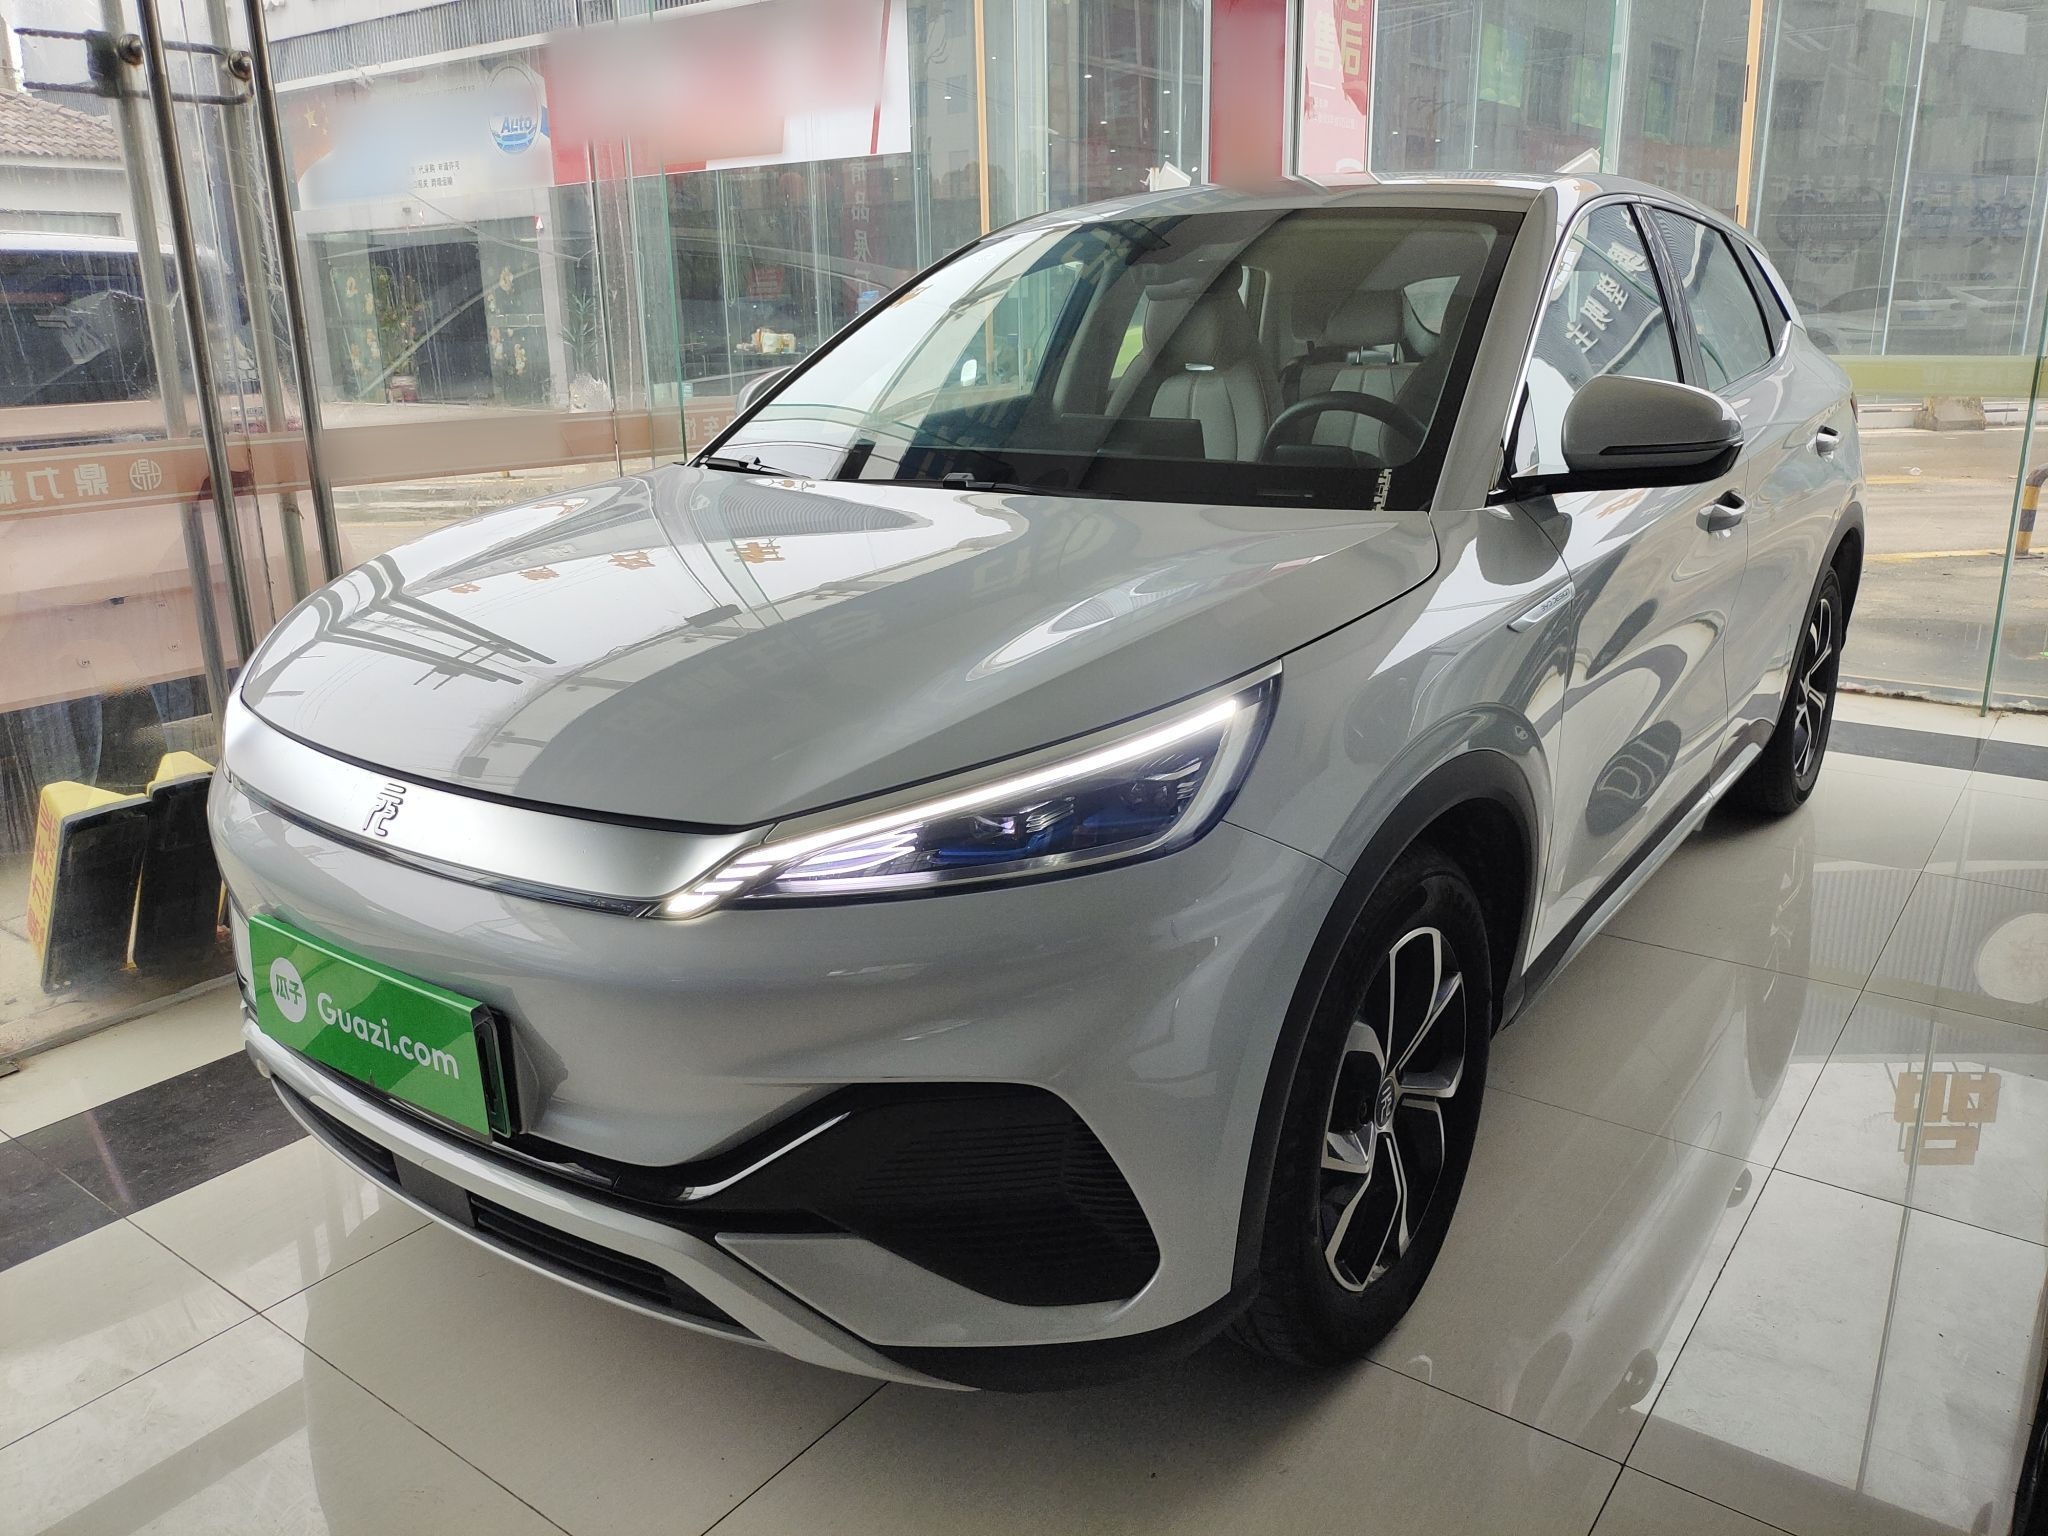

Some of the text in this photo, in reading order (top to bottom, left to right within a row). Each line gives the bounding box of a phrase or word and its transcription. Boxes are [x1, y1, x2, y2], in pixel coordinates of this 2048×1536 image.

[501, 114, 533, 133] Auto
[275, 973, 303, 1005] 瓜子
[317, 992, 460, 1080] Guazi.com
